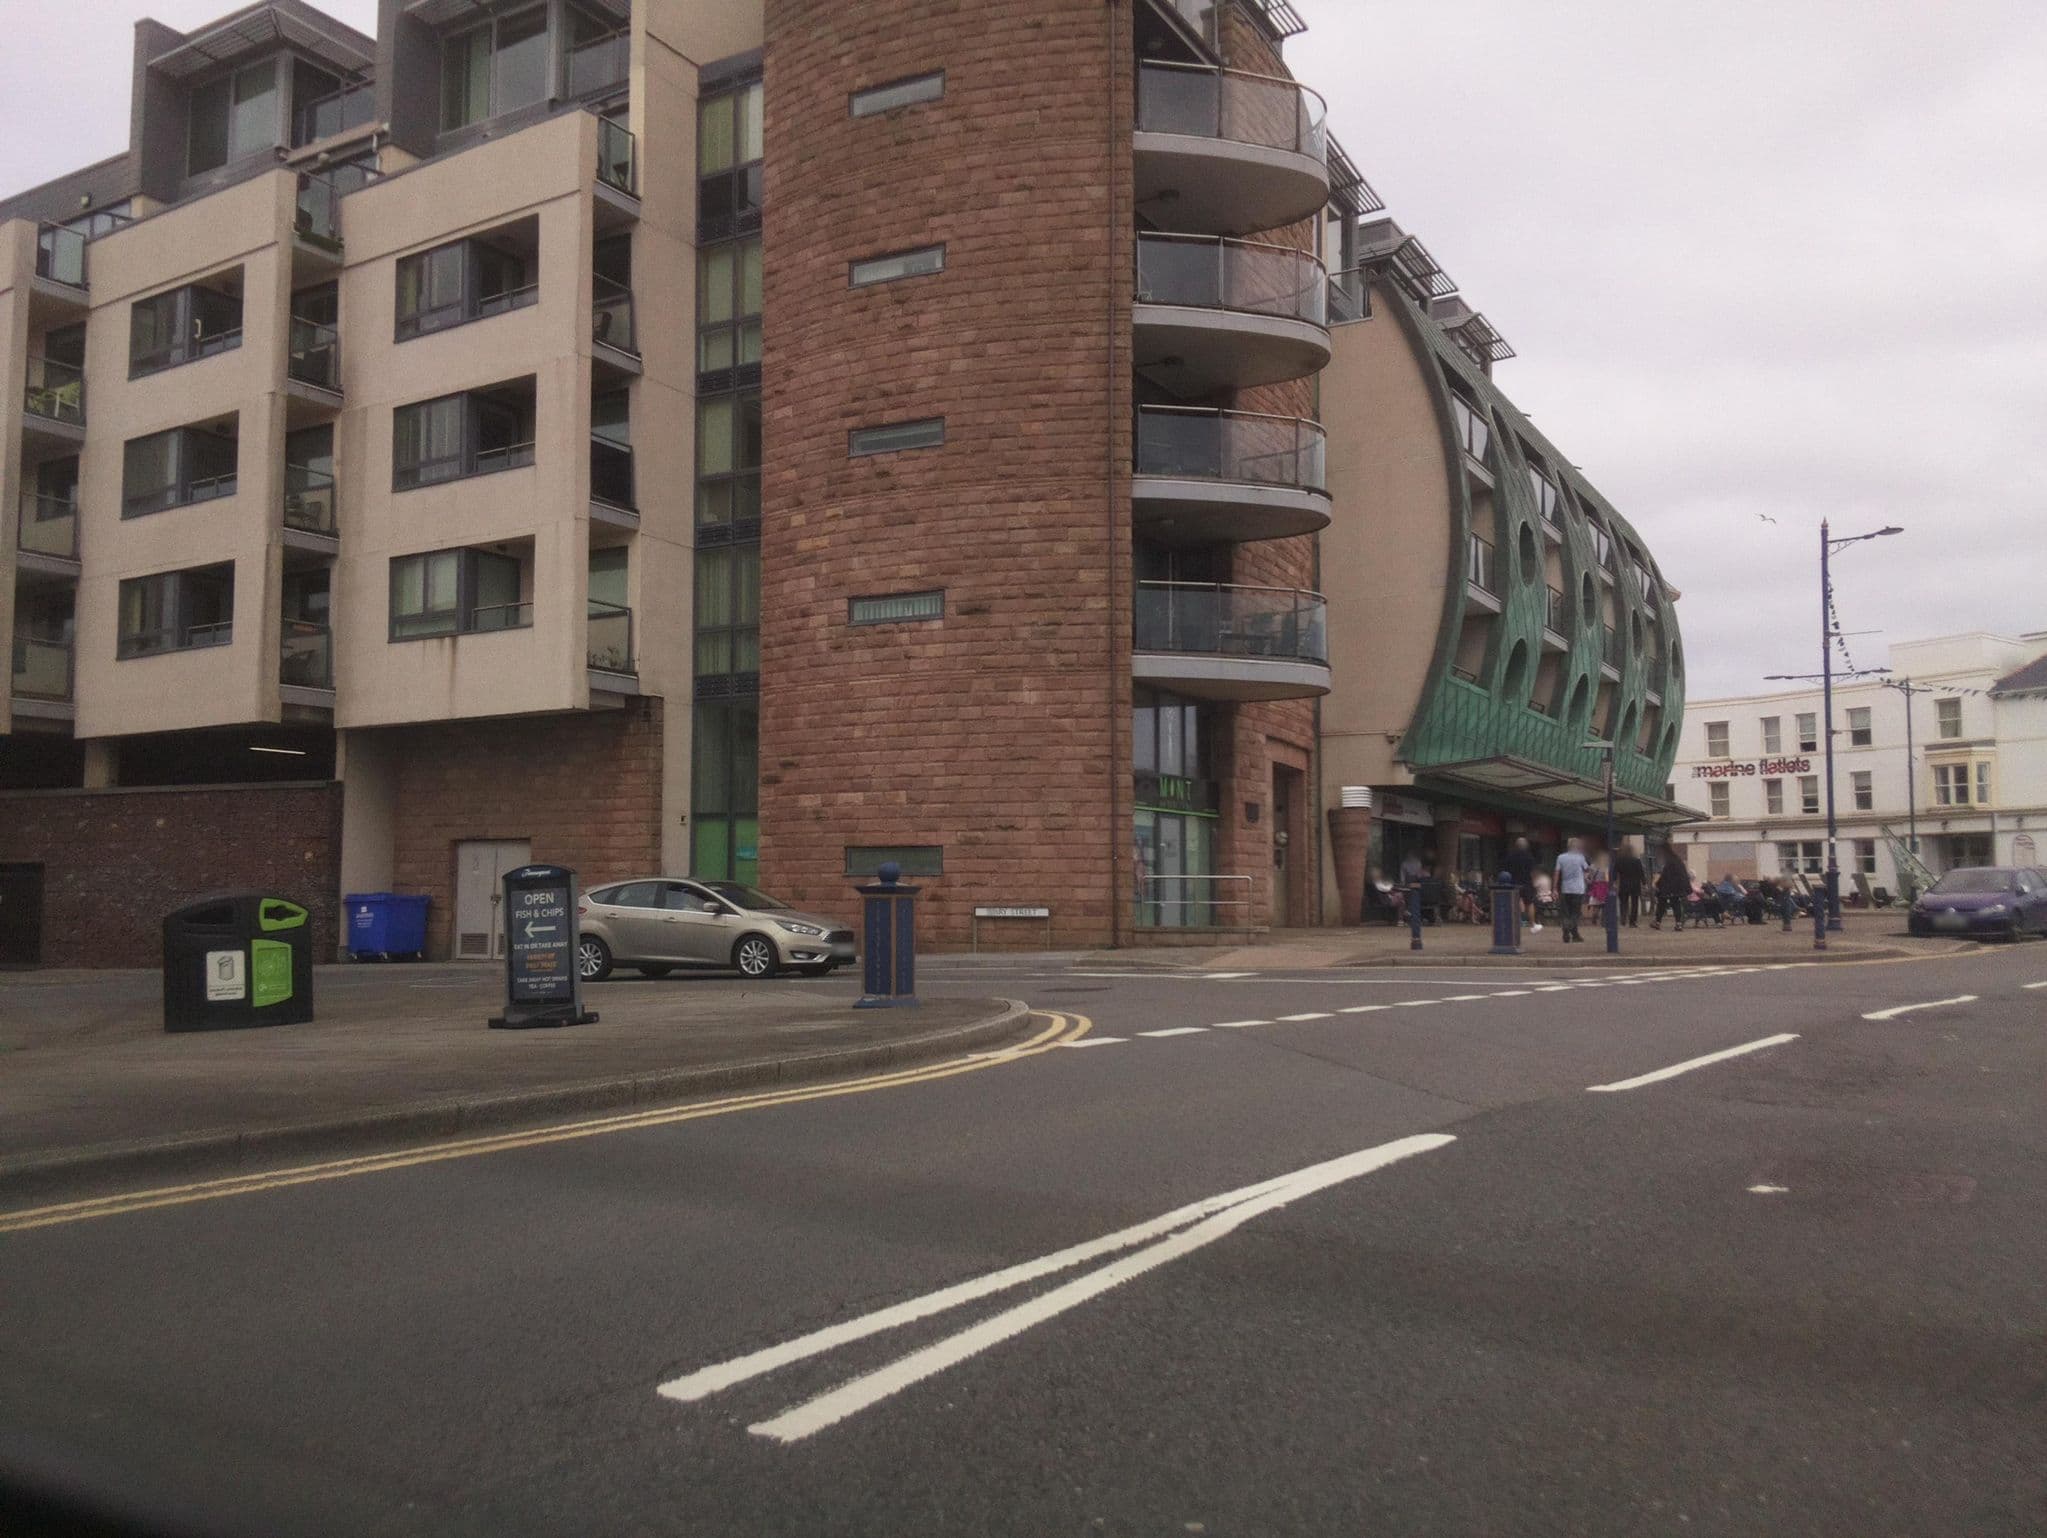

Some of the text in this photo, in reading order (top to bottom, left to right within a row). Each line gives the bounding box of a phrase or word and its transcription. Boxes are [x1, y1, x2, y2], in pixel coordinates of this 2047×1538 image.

[1697, 761, 1756, 778] marine
[1759, 757, 1811, 775] flatlets
[1159, 776, 1192, 801] MINT
[524, 892, 555, 905] OPEN
[515, 907, 565, 919] FISH & CHIPS
